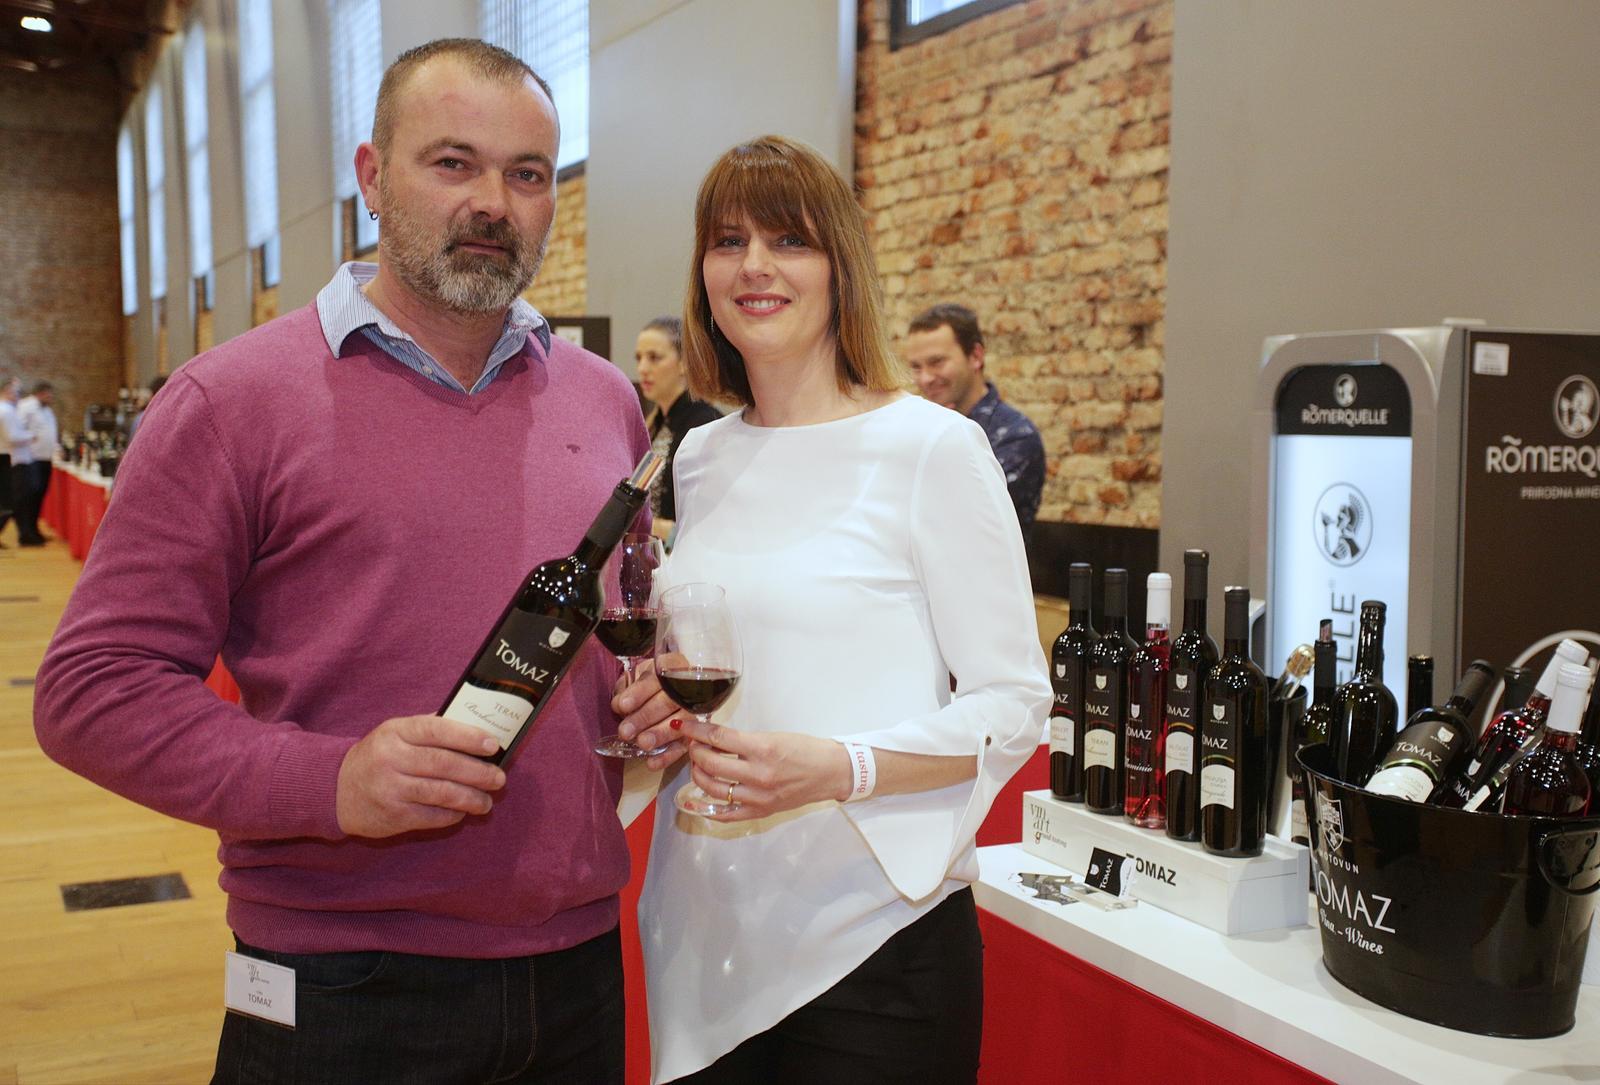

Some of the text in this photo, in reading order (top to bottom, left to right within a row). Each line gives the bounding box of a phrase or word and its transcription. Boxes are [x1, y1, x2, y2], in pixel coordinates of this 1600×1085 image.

[496, 639, 549, 684] TOMAZ
[493, 702, 522, 721] TERAN
[1396, 741, 1442, 767] TOMAZ
[856, 752, 868, 793] tasting
[1099, 858, 1114, 889] TOMAZ
[1345, 926, 1384, 956] Wines
[248, 993, 272, 1008] TOMAZ
